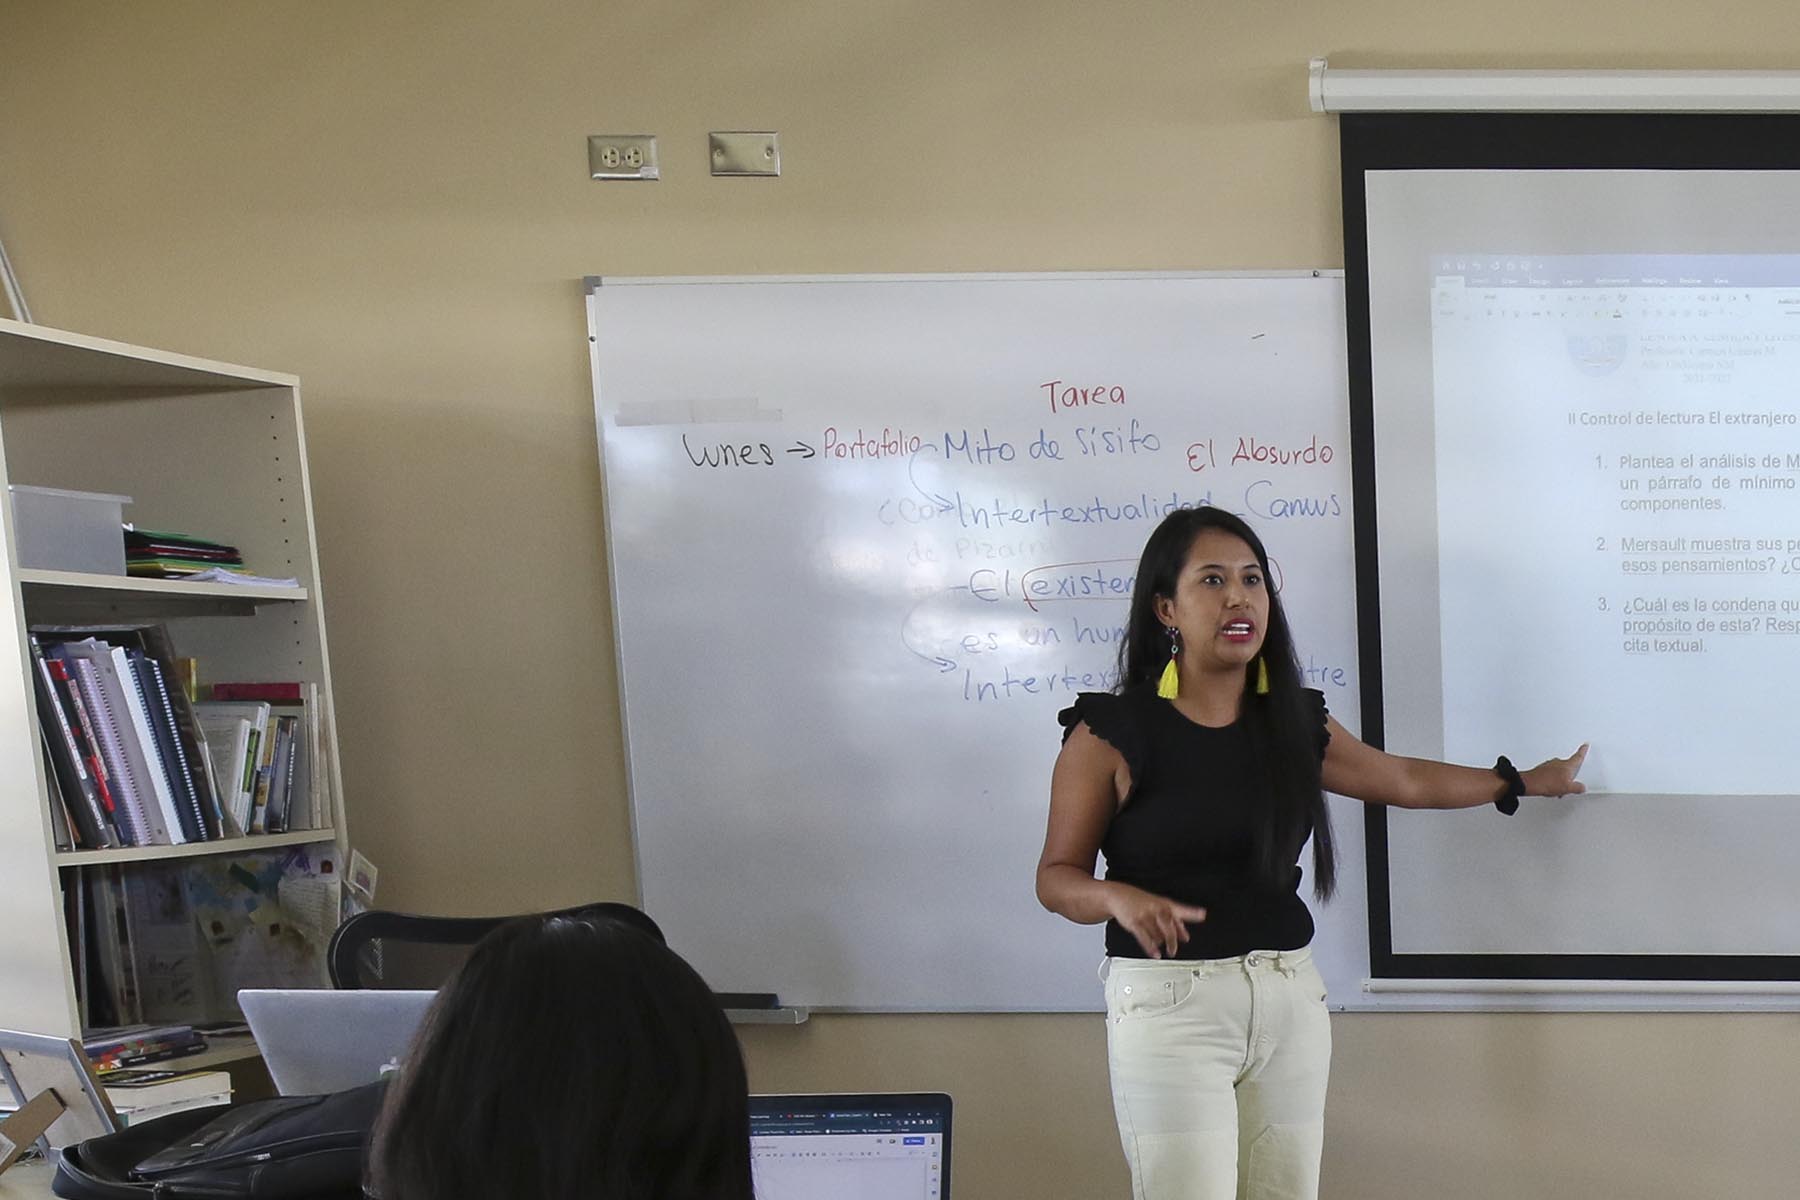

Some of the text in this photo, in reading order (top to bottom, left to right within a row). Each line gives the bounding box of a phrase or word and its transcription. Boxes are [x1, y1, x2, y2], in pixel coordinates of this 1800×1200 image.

[1040, 381, 1126, 414] Tarea
[1579, 412, 1632, 425] Control
[1635, 412, 1653, 424] de
[1656, 411, 1705, 424] lectura
[1709, 411, 1721, 424] El
[1724, 412, 1797, 427] extranjero
[822, 425, 922, 461] Portafolio
[943, 428, 1017, 463] Mito
[1029, 428, 1065, 461] de
[1075, 418, 1161, 455] Sísifo
[1186, 435, 1334, 472] El Absurdo
[1620, 456, 1674, 468] Plantea
[1680, 455, 1694, 467] el
[1699, 455, 1756, 468] análisis
[1762, 455, 1781, 467] de
[1619, 480, 1639, 490] un
[1648, 475, 1702, 492] párrafo
[1711, 476, 1731, 489] de
[1739, 475, 1796, 489] mínimo
[1620, 497, 1726, 513] componentes.
[1596, 537, 1609, 551] 2.
[1621, 538, 1686, 554] Mersault
[1690, 538, 1751, 554] muestra
[1756, 540, 1783, 550] sus
[1621, 560, 1657, 572] esos
[1661, 557, 1777, 575] pensamientos?
[968, 569, 1010, 603] El
[1597, 597, 1611, 611] 3.
[1623, 597, 1667, 614] ¿Cuál
[1672, 601, 1690, 612] es
[1694, 598, 1707, 611] la
[1711, 597, 1777, 614] condena
[1622, 619, 1693, 635] propósito
[1695, 619, 1716, 632] de
[1719, 619, 1761, 632] esta?
[959, 630, 999, 656] es
[1622, 638, 1708, 653] cita textual.
[962, 663, 1120, 702] Intertex
